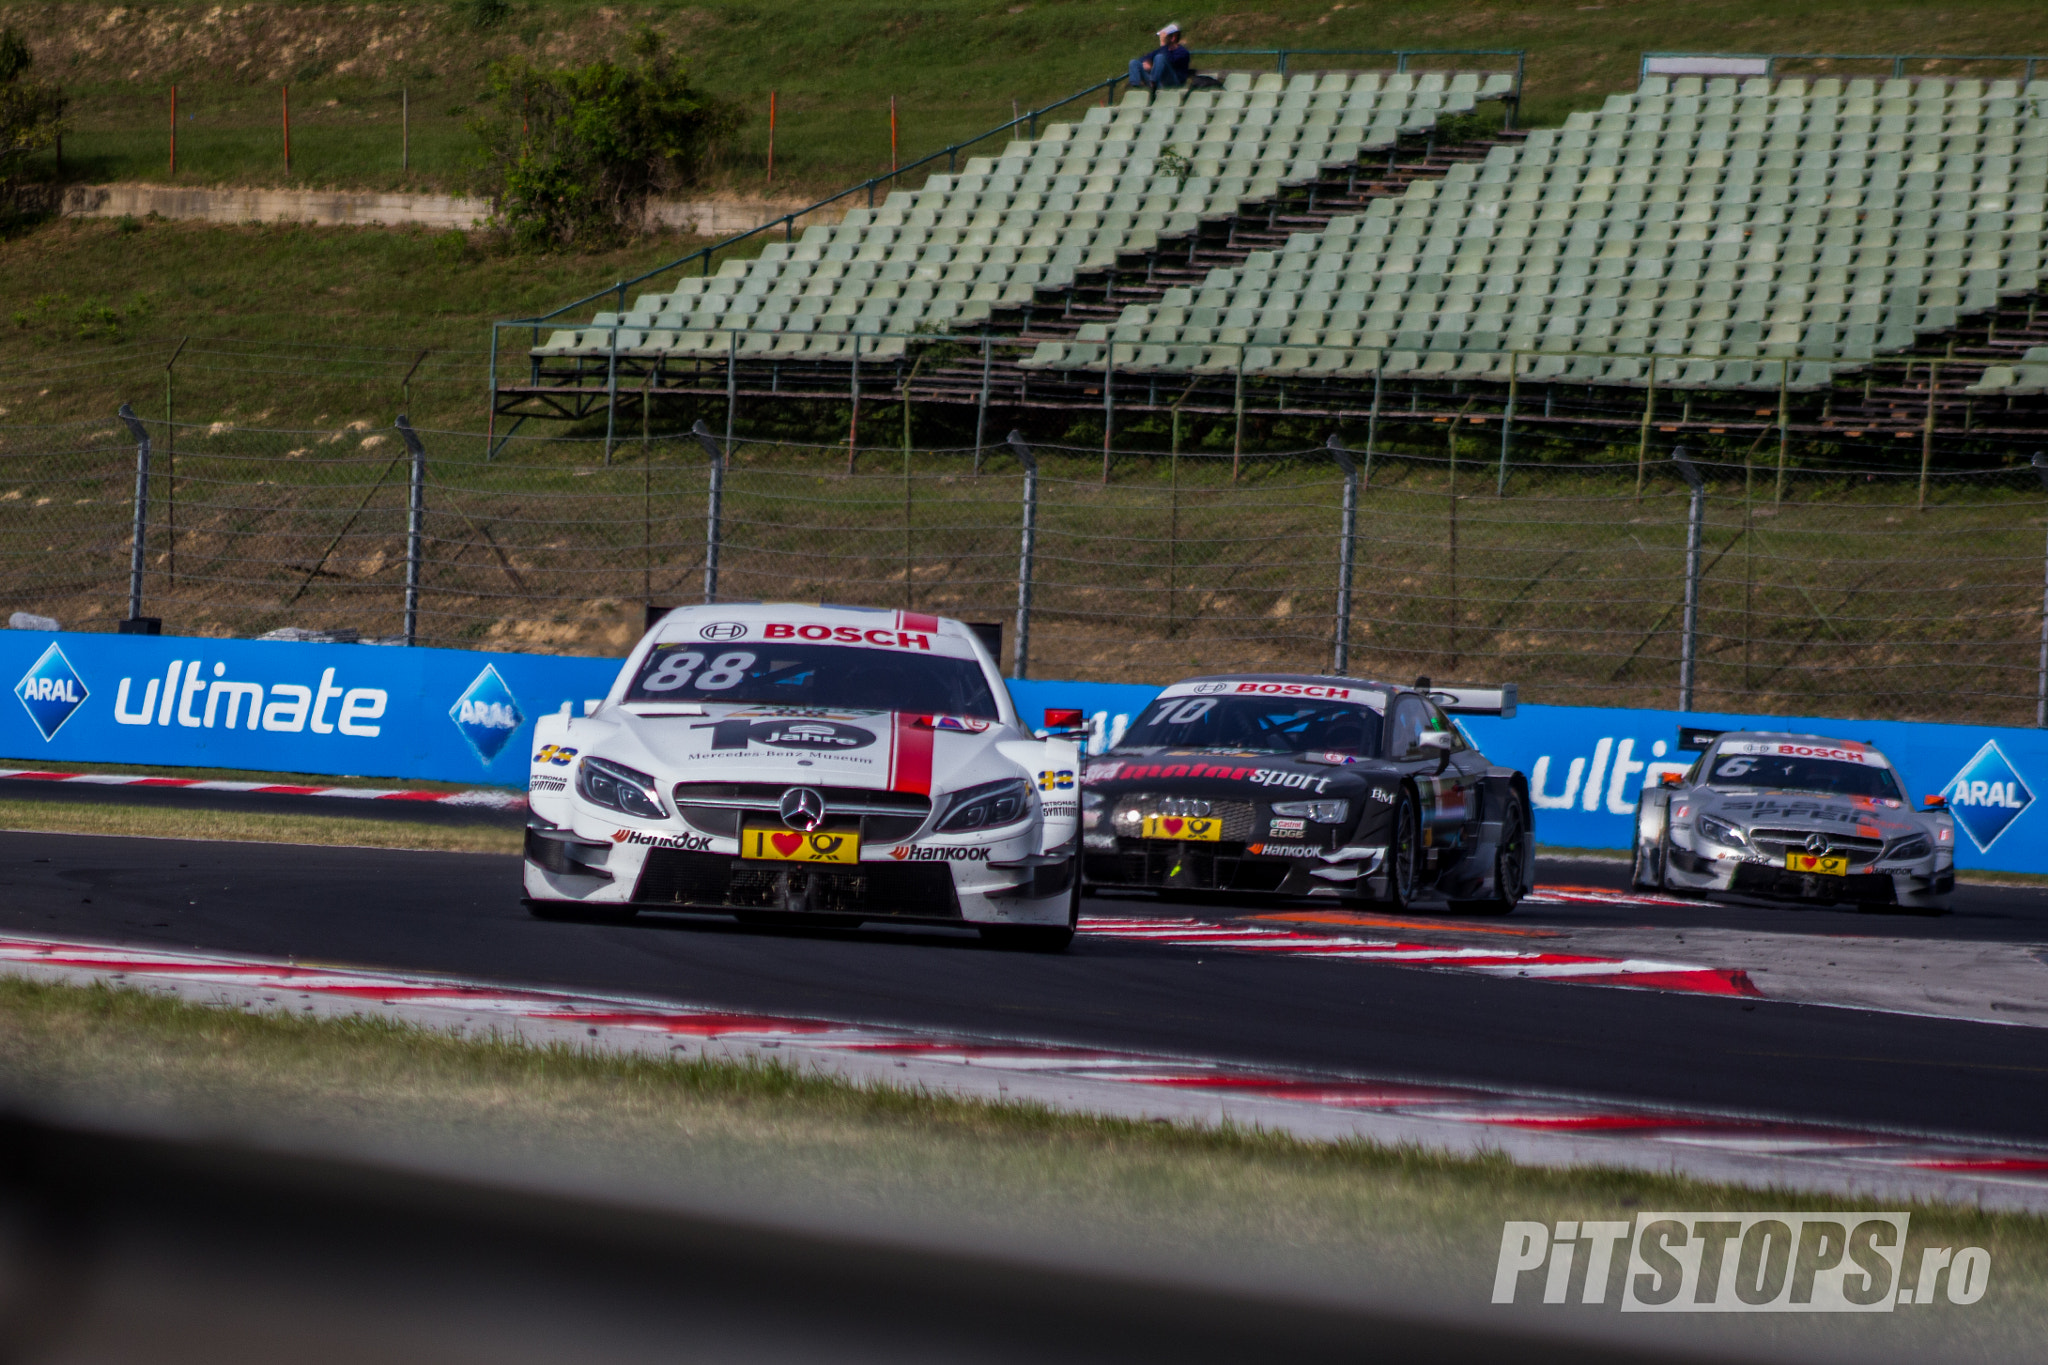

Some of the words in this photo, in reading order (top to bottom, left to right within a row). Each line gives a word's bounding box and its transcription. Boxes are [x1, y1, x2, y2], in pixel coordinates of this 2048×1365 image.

[763, 623, 931, 650] BOSCH
[642, 652, 756, 691] 88
[24, 678, 79, 703] ARAL
[115, 660, 388, 737] ultimate
[1235, 683, 1349, 699] BOSCH
[460, 699, 514, 727] ARAL
[1148, 700, 1217, 726] 10
[533, 744, 579, 766] 88
[688, 751, 803, 761] Mercedes-Benz
[809, 752, 874, 764] Museum
[1778, 745, 1864, 763] BOSCH
[1530, 737, 1692, 815] ulti
[1716, 756, 1758, 777] 6
[531, 775, 568, 783] PETRONAS
[1038, 770, 1074, 791] 88
[1371, 787, 1394, 804] BM
[1952, 780, 2022, 809] ARAL
[1269, 829, 1305, 838] EDGE
[1278, 820, 1303, 830] Castrol
